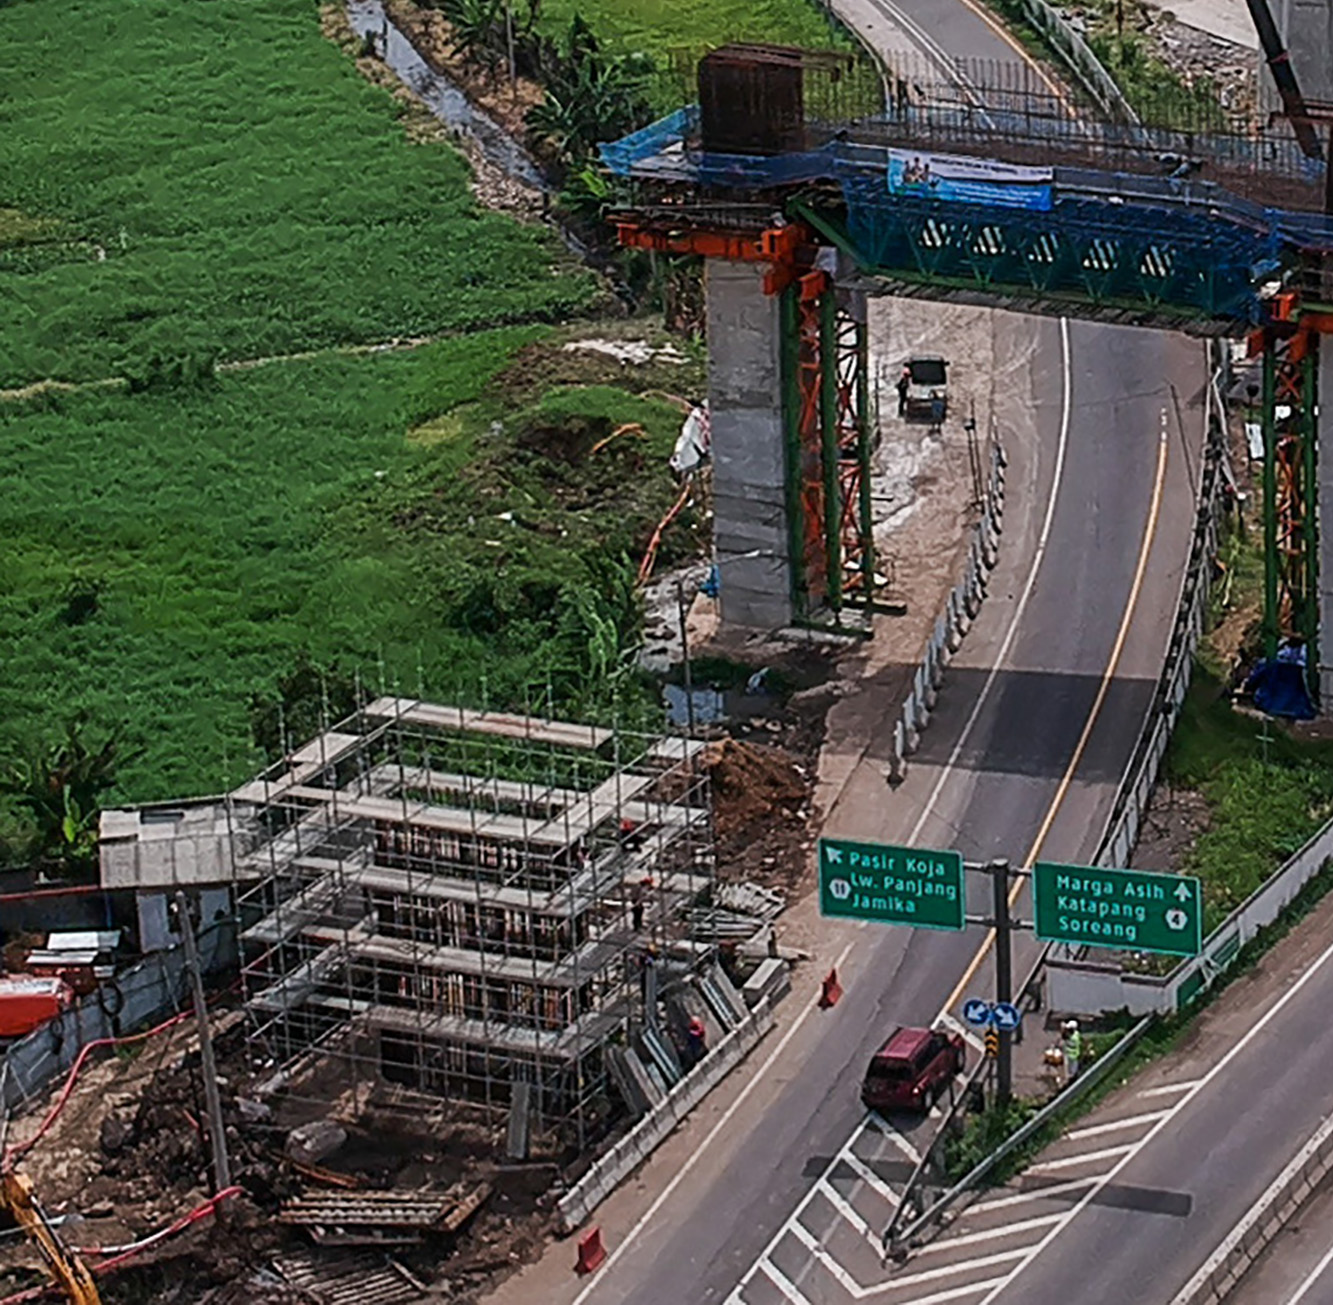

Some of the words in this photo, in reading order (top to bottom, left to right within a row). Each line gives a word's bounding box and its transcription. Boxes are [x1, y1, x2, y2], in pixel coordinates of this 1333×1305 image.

[849, 851, 895, 870] Pasir
[905, 858, 945, 878] Koja
[850, 871, 879, 889] Lw.
[883, 876, 957, 902] Panjang
[1056, 874, 1114, 896] Marga
[1124, 881, 1165, 899] Asih
[851, 893, 917, 913] Jamika
[1057, 895, 1146, 922] Katapang
[1058, 915, 1137, 942] Soreang
[1170, 912, 1181, 927] 4
